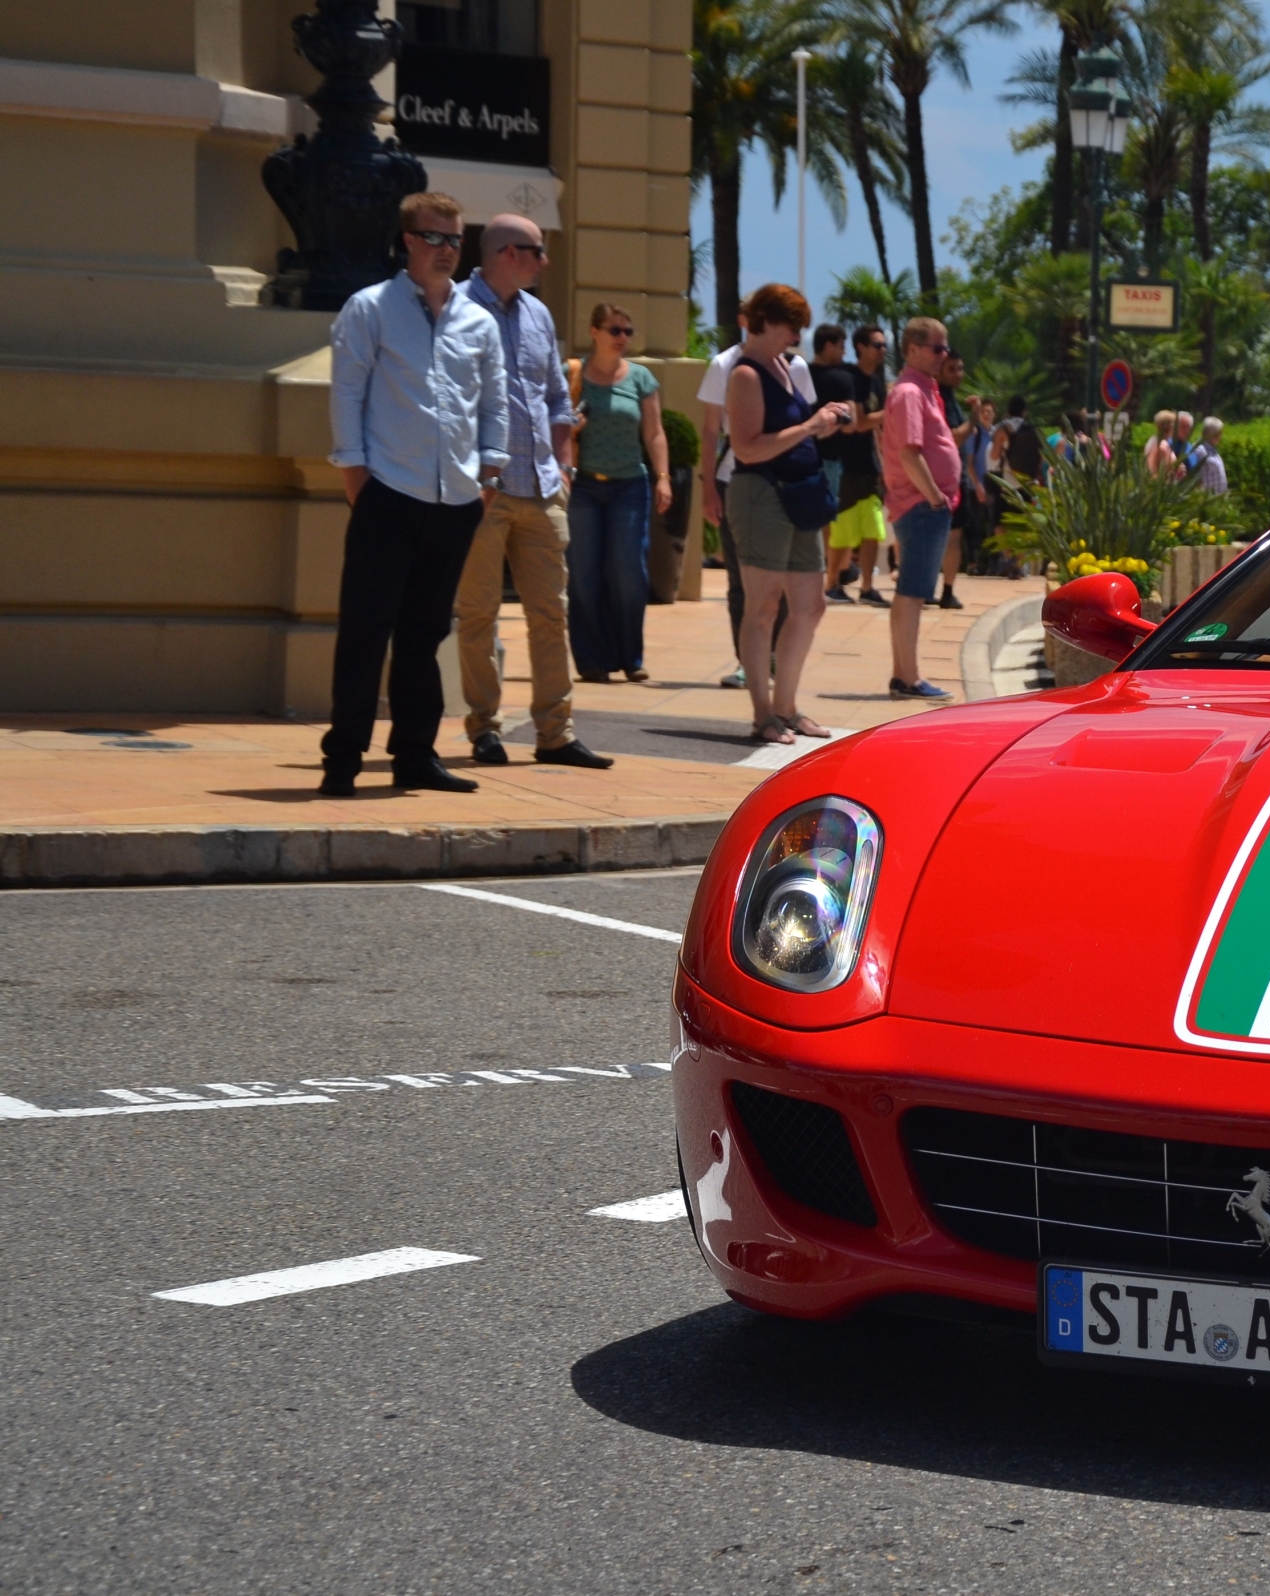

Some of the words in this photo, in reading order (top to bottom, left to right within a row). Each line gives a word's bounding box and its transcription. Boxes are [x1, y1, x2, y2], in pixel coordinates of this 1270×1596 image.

[399, 94, 455, 125] Cleef
[457, 106, 473, 128] &
[477, 104, 540, 140] Arpels
[1124, 287, 1163, 302] TAXIS
[1058, 1318, 1071, 1336] D
[1088, 1282, 1197, 1354] STA
